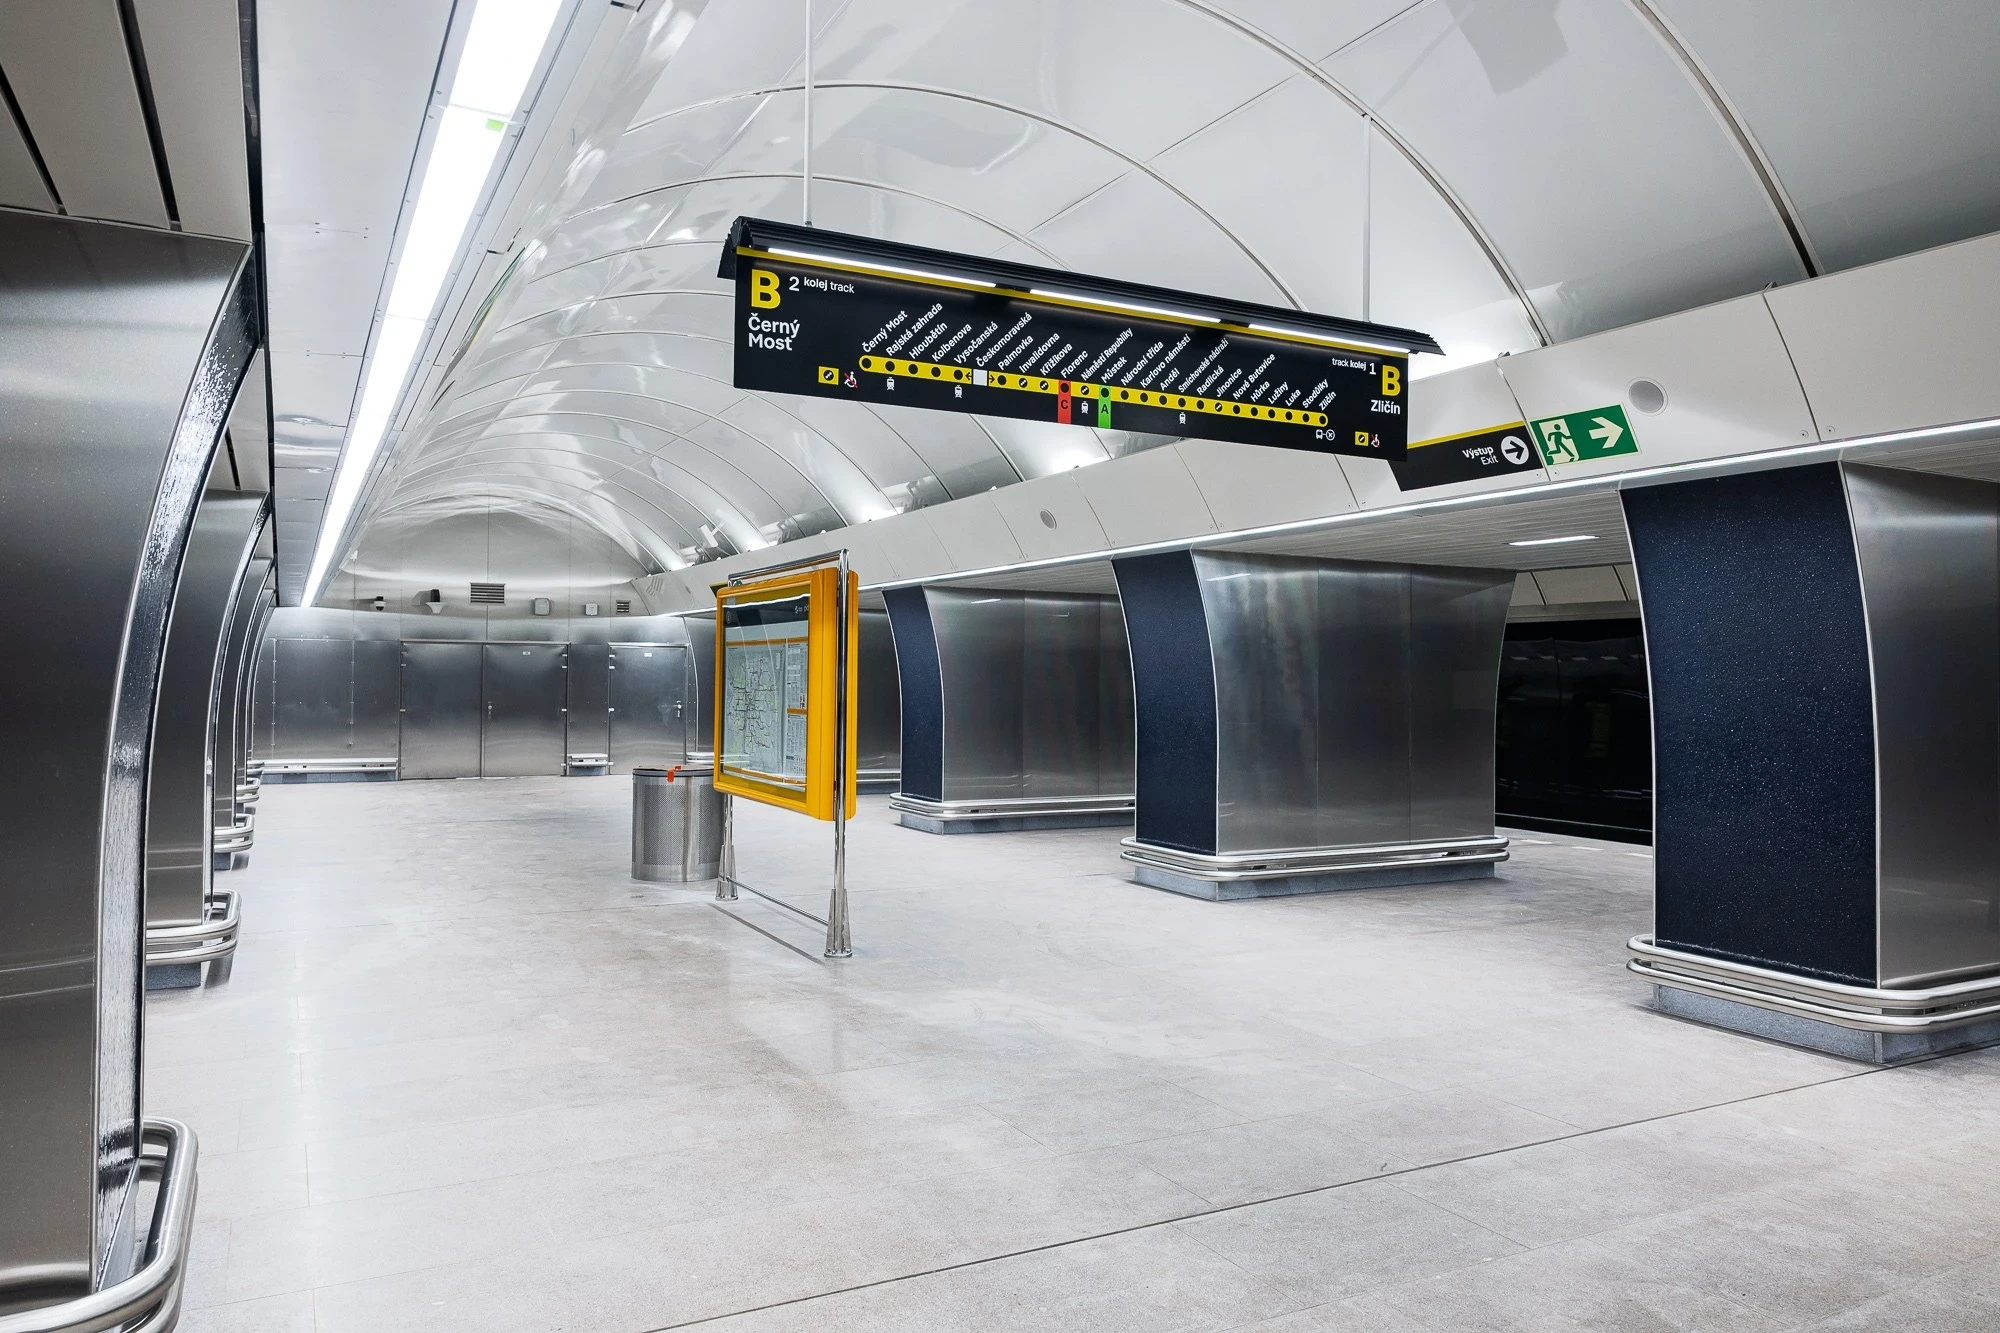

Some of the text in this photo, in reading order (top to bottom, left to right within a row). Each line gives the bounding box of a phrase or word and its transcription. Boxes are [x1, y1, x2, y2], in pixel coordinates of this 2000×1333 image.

[752, 269, 781, 309] B
[789, 276, 855, 294] 2 kolej track
[748, 312, 800, 338] Černý
[862, 310, 908, 352] Černý Most
[885, 303, 943, 356] Rajská zahrada
[975, 312, 1033, 367] Českomoravská
[748, 333, 793, 351] Most
[908, 322, 948, 359] Hloubětín
[932, 323, 972, 362] Kolbenova
[953, 321, 998, 364] Vysočanská
[997, 335, 1034, 371] Palmovka
[1019, 333, 1060, 374] Invalidovna
[1080, 327, 1134, 381] Náměstí Republiky
[1040, 343, 1073, 376] Křižíkova
[1060, 350, 1089, 379] Florenc
[1101, 356, 1128, 383] Můstek
[1120, 341, 1164, 386] Národní třída
[1140, 333, 1191, 388] Karlovo náměstí
[1178, 337, 1229, 393] Smíchovské nádraží
[1332, 357, 1377, 375] track kolej 1
[1160, 367, 1180, 391] Anděl
[1196, 365, 1224, 395] Radlická
[1216, 368, 1242, 397] Jinonice
[1232, 353, 1275, 400] Nové Butovice
[1250, 380, 1270, 403] Hůrka
[1382, 365, 1401, 396] B
[1060, 399, 1069, 410] C
[1267, 381, 1289, 404] Lužiny
[1285, 389, 1301, 407] Luka
[1302, 378, 1329, 408] Stodůlky
[1319, 391, 1337, 411] Zličín
[1370, 400, 1401, 415] Zličín
[1100, 403, 1109, 414] A
[1462, 446, 1494, 460] Výstup
[1480, 455, 1499, 466] Exit
